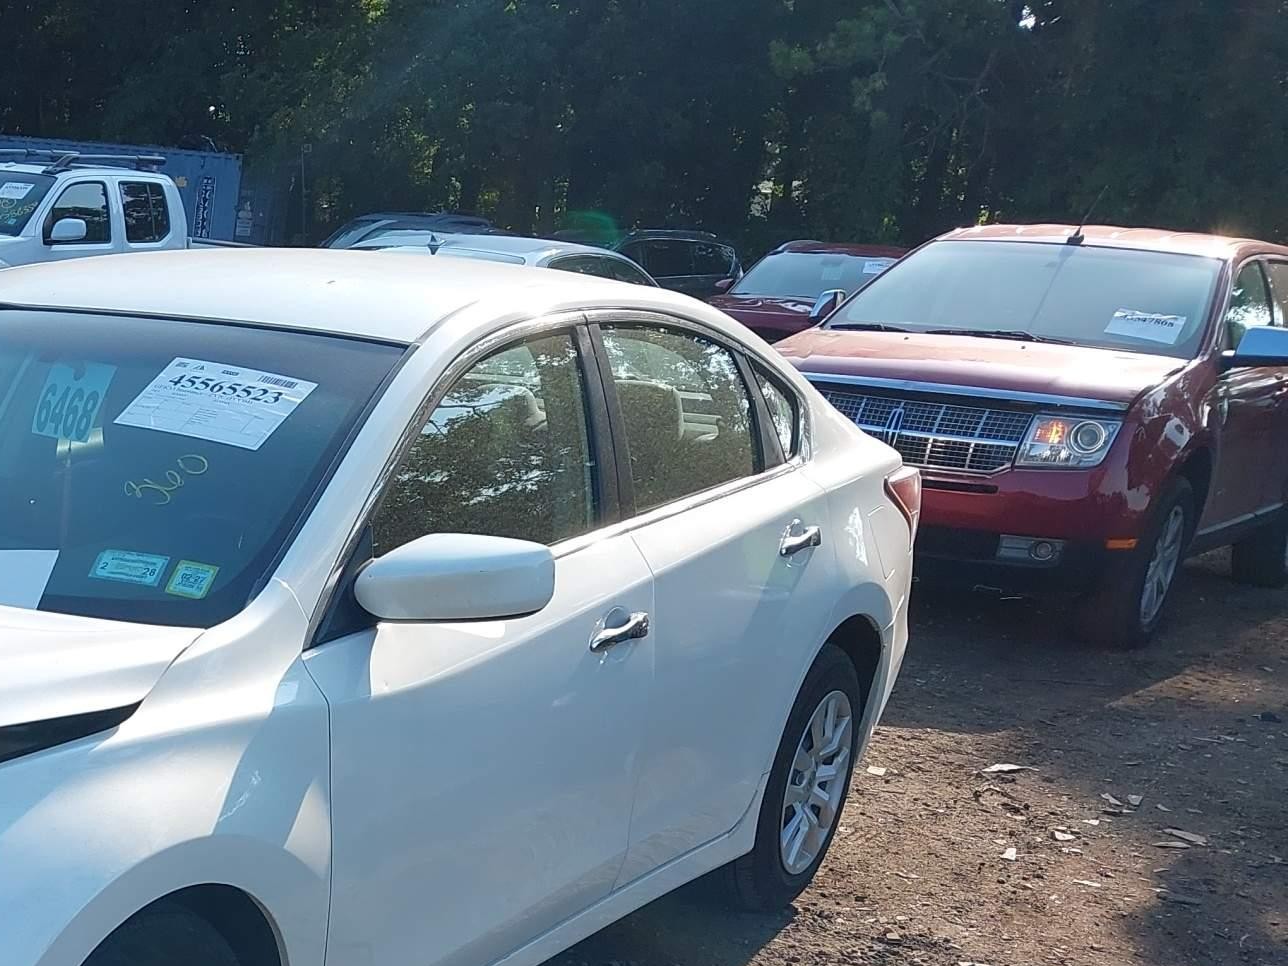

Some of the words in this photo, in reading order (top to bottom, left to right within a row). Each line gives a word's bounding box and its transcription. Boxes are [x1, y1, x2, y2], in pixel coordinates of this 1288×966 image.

[168, 374, 284, 404] 45565523
[36, 383, 100, 441] 6468
[100, 561, 109, 570] 2
[142, 567, 157, 577] 28
